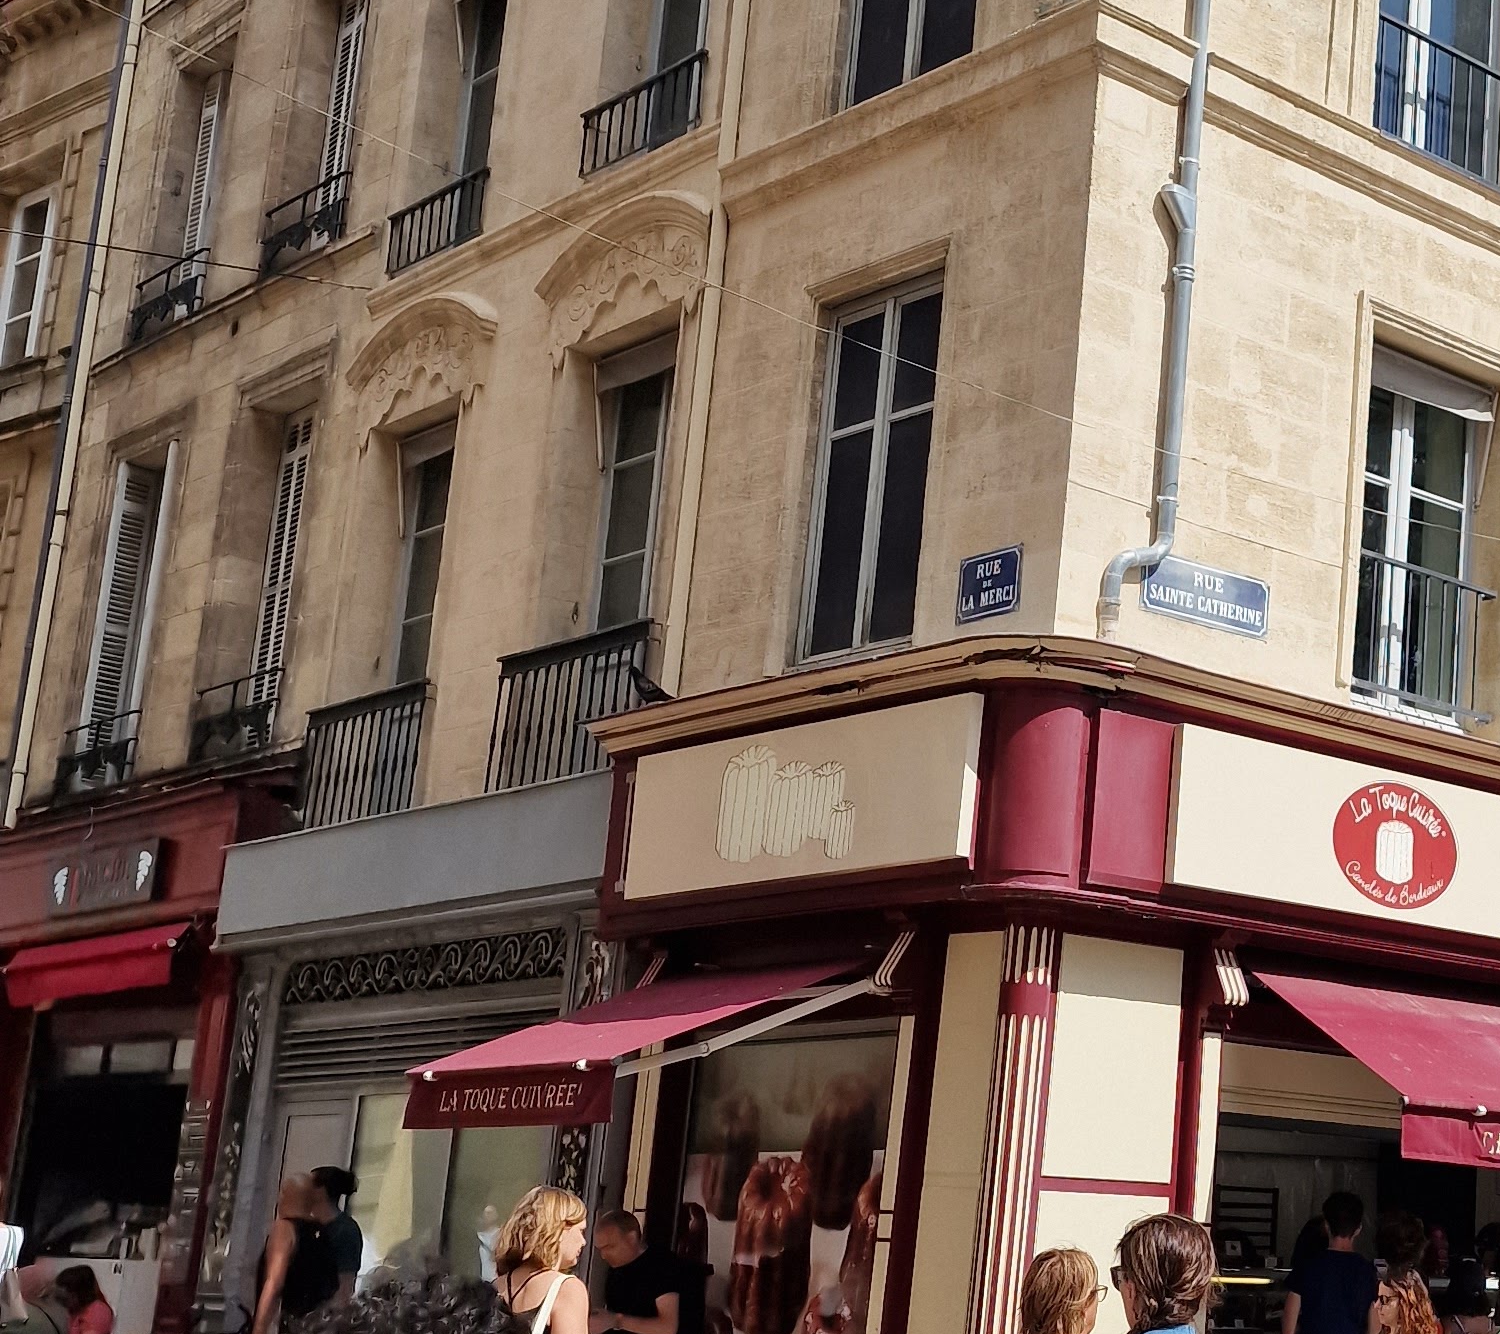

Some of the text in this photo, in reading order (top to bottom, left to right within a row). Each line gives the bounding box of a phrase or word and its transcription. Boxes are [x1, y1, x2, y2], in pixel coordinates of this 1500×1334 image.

[976, 559, 1002, 579] RUE
[1194, 571, 1224, 594] RUE
[982, 579, 993, 588] DE
[961, 585, 1014, 612] LA MERCI
[1149, 584, 1263, 626] SAINTE CATHERINE
[1349, 798, 1372, 823] La
[1369, 786, 1407, 819] Toque
[1346, 861, 1444, 905] Canelés de Bordeaux
[439, 1090, 458, 1112] LA
[462, 1086, 510, 1113] TOQUE
